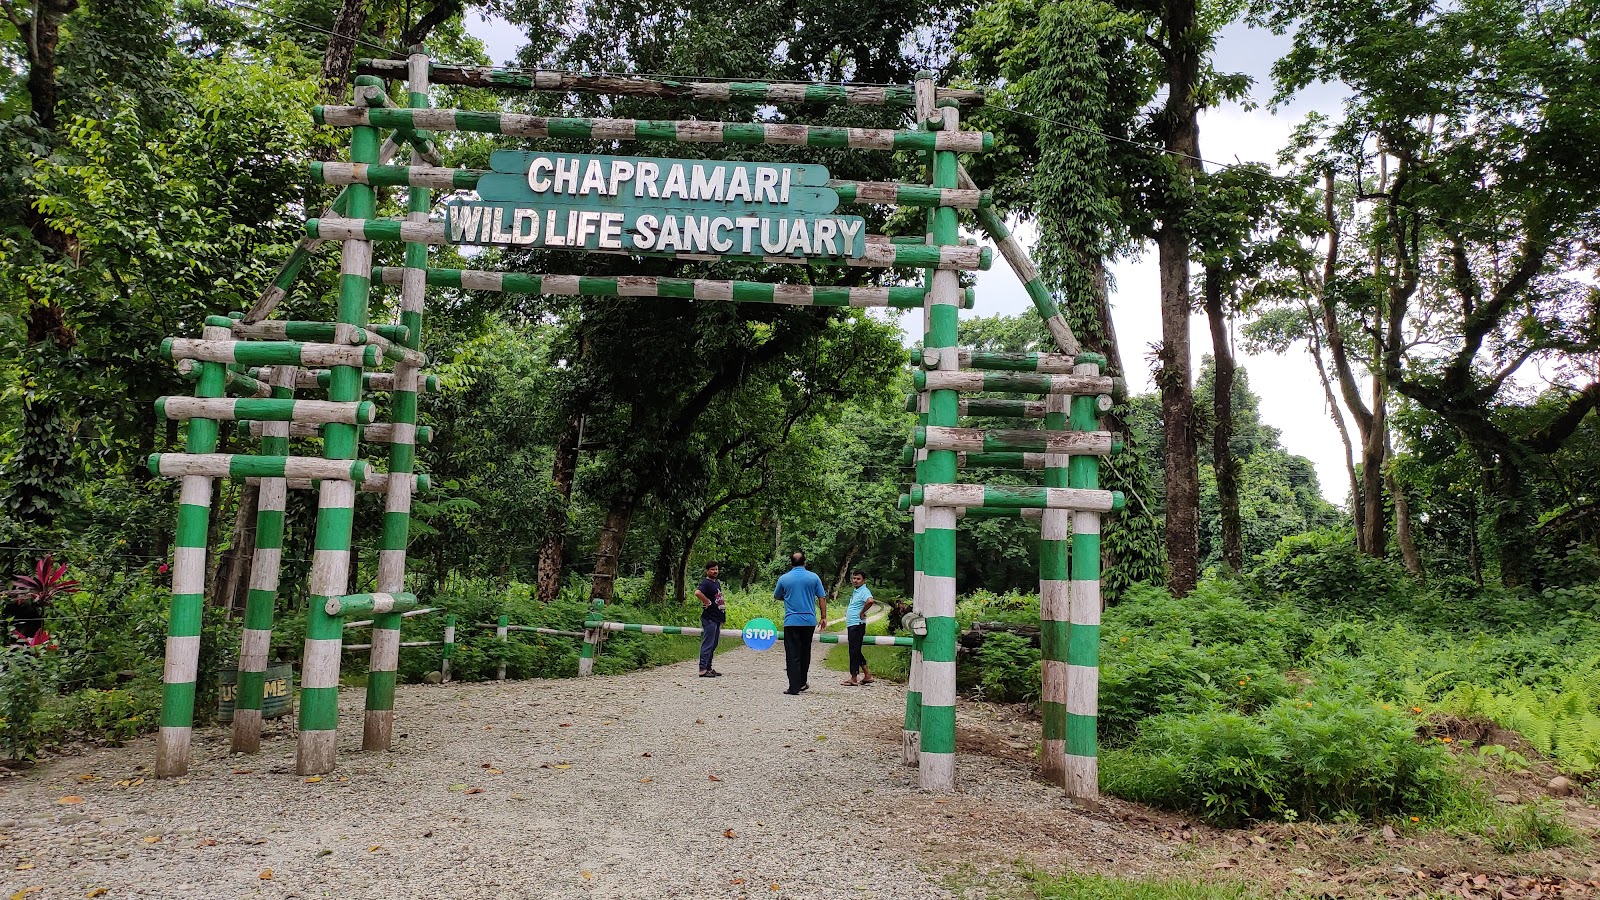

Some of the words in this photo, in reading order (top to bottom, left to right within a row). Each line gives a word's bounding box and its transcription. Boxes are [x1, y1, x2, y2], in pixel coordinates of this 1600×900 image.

[528, 157, 791, 203] CHAPRAMARI
[450, 204, 539, 244] WILD
[547, 209, 624, 249] LIFE
[633, 214, 862, 255] SANCTUARY
[746, 628, 775, 640] STOP
[221, 684, 238, 701] US
[264, 679, 287, 699] ME
